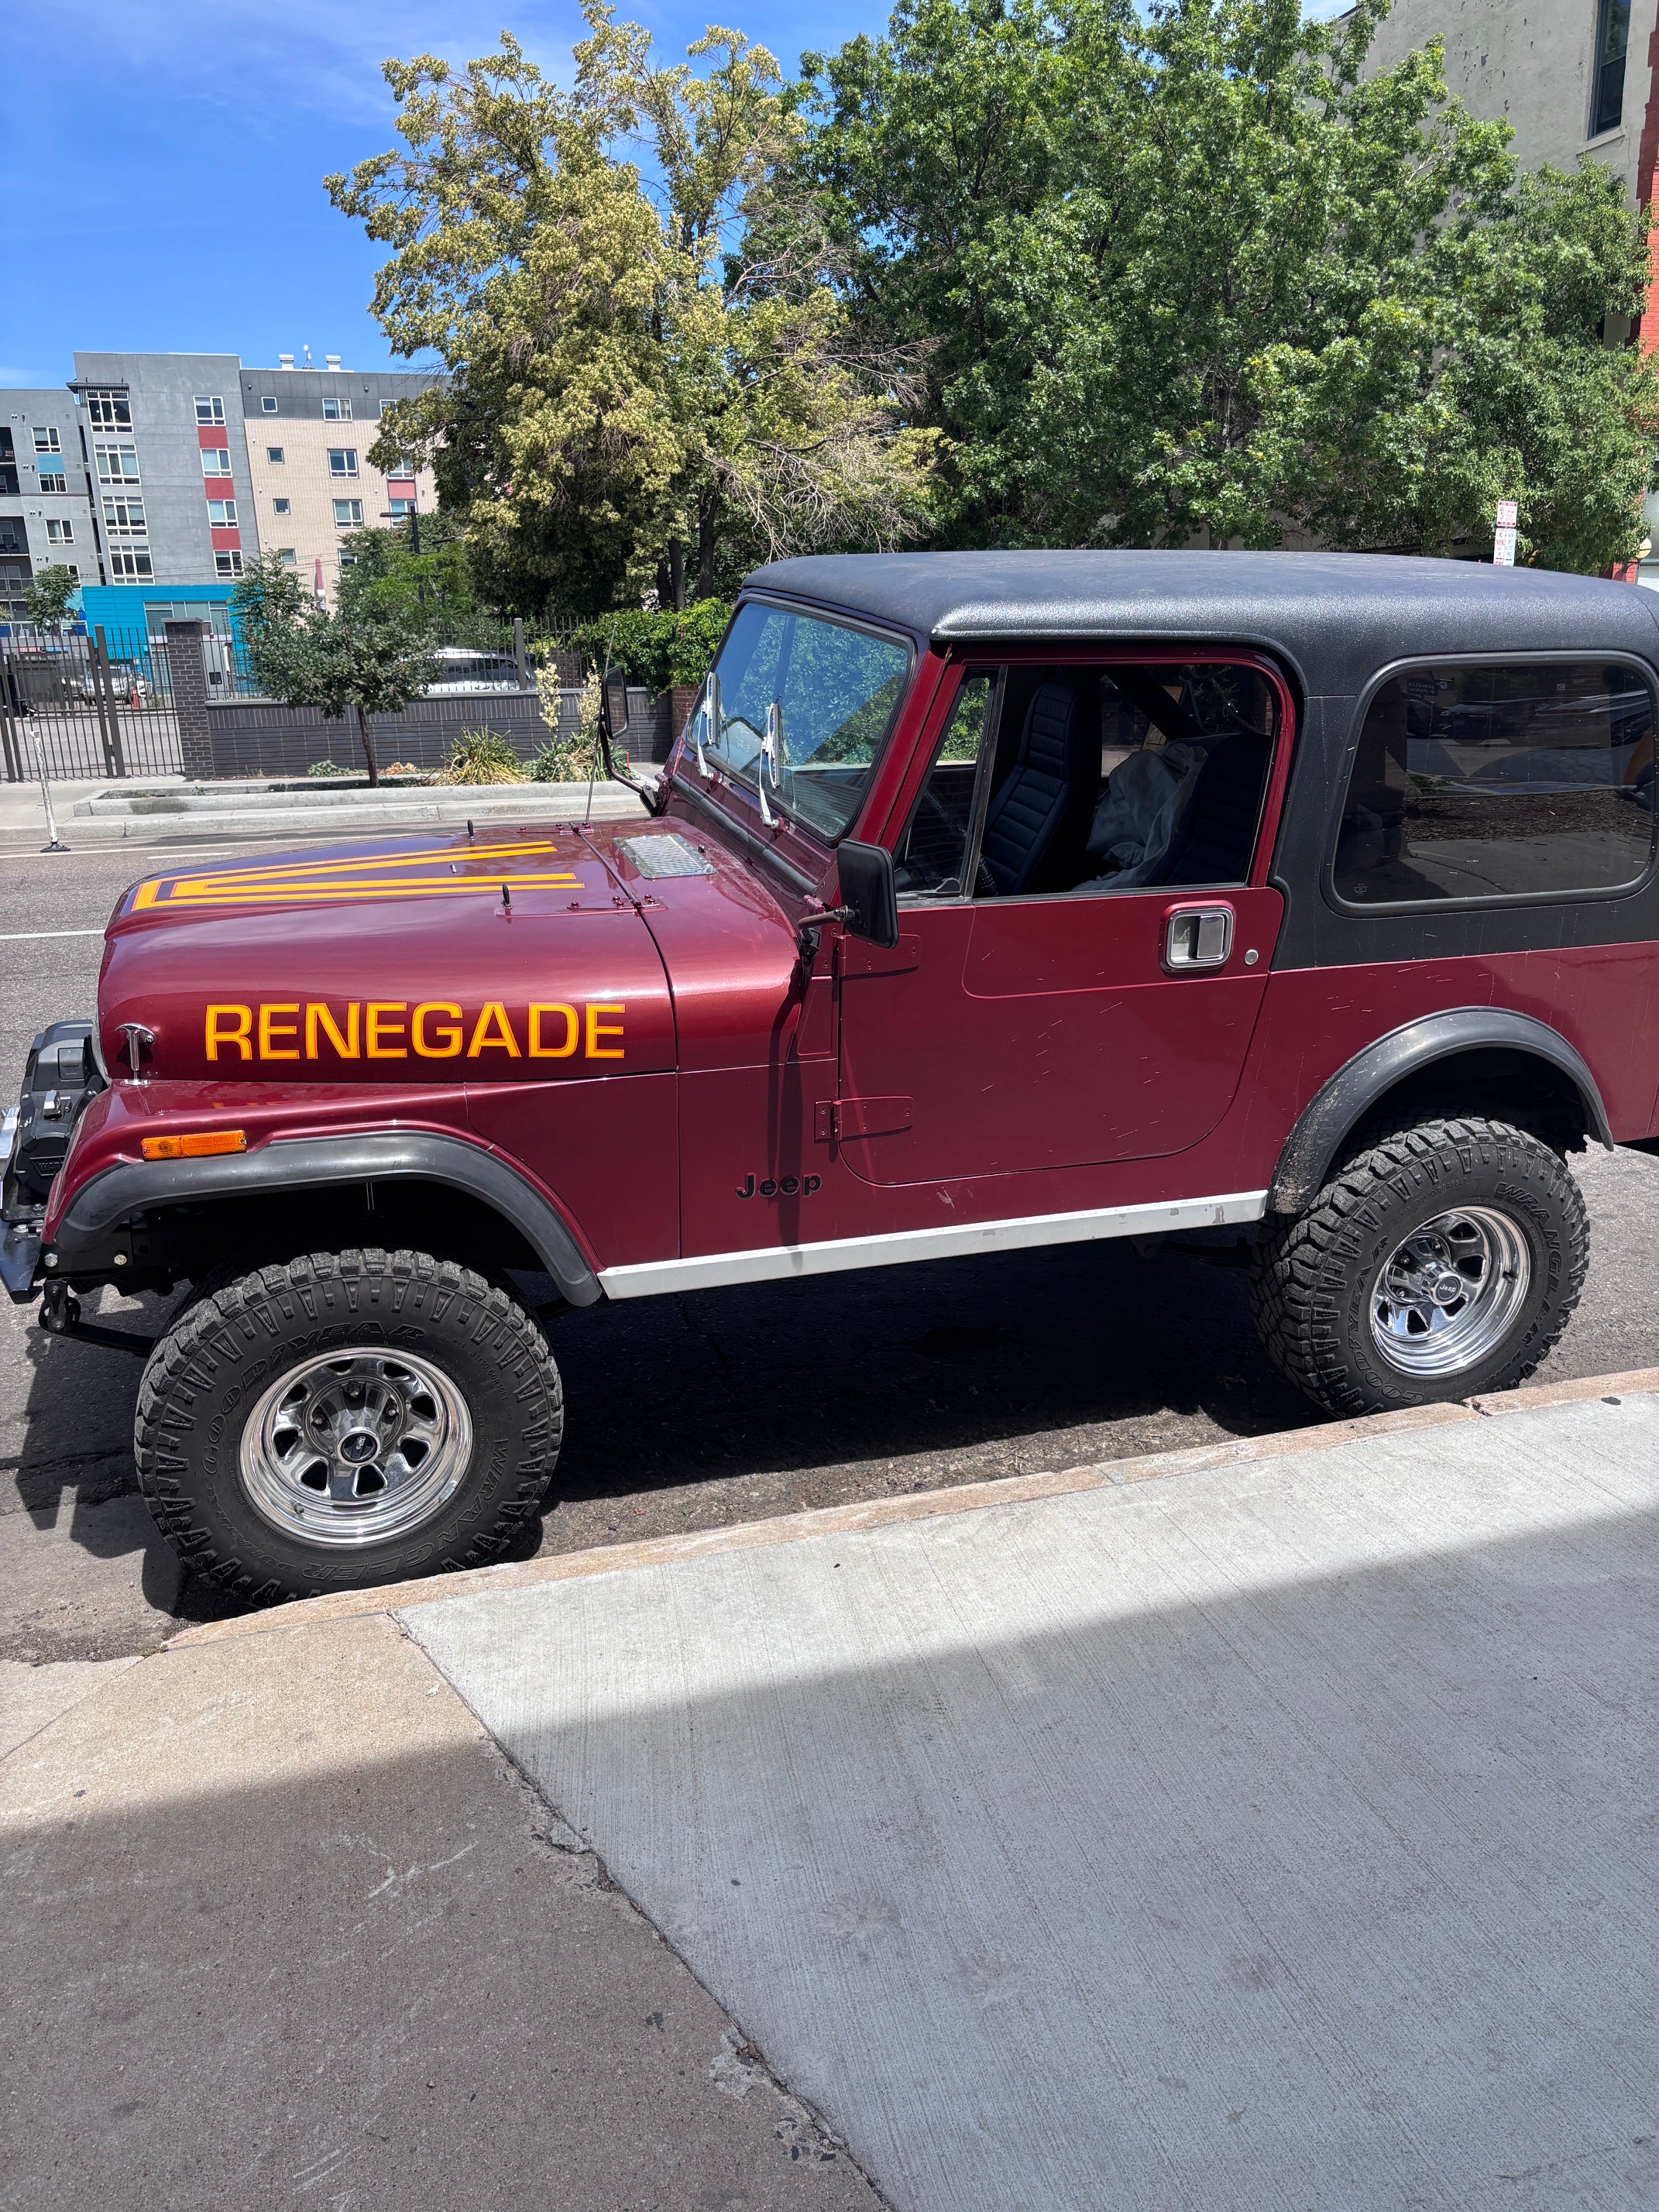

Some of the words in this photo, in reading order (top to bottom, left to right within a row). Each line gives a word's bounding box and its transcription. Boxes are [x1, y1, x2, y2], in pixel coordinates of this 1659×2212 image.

[204, 1001, 626, 1060] RENEGADE
[734, 1172, 823, 1200] Jeep
[1348, 1235, 1424, 1405] GOODYEAR
[1440, 1283, 1456, 1293] Jeep
[1496, 1181, 1563, 1347] WRANGLER
[204, 1321, 425, 1475] GOODYEAR
[303, 1439, 509, 1581] WRANGLER
